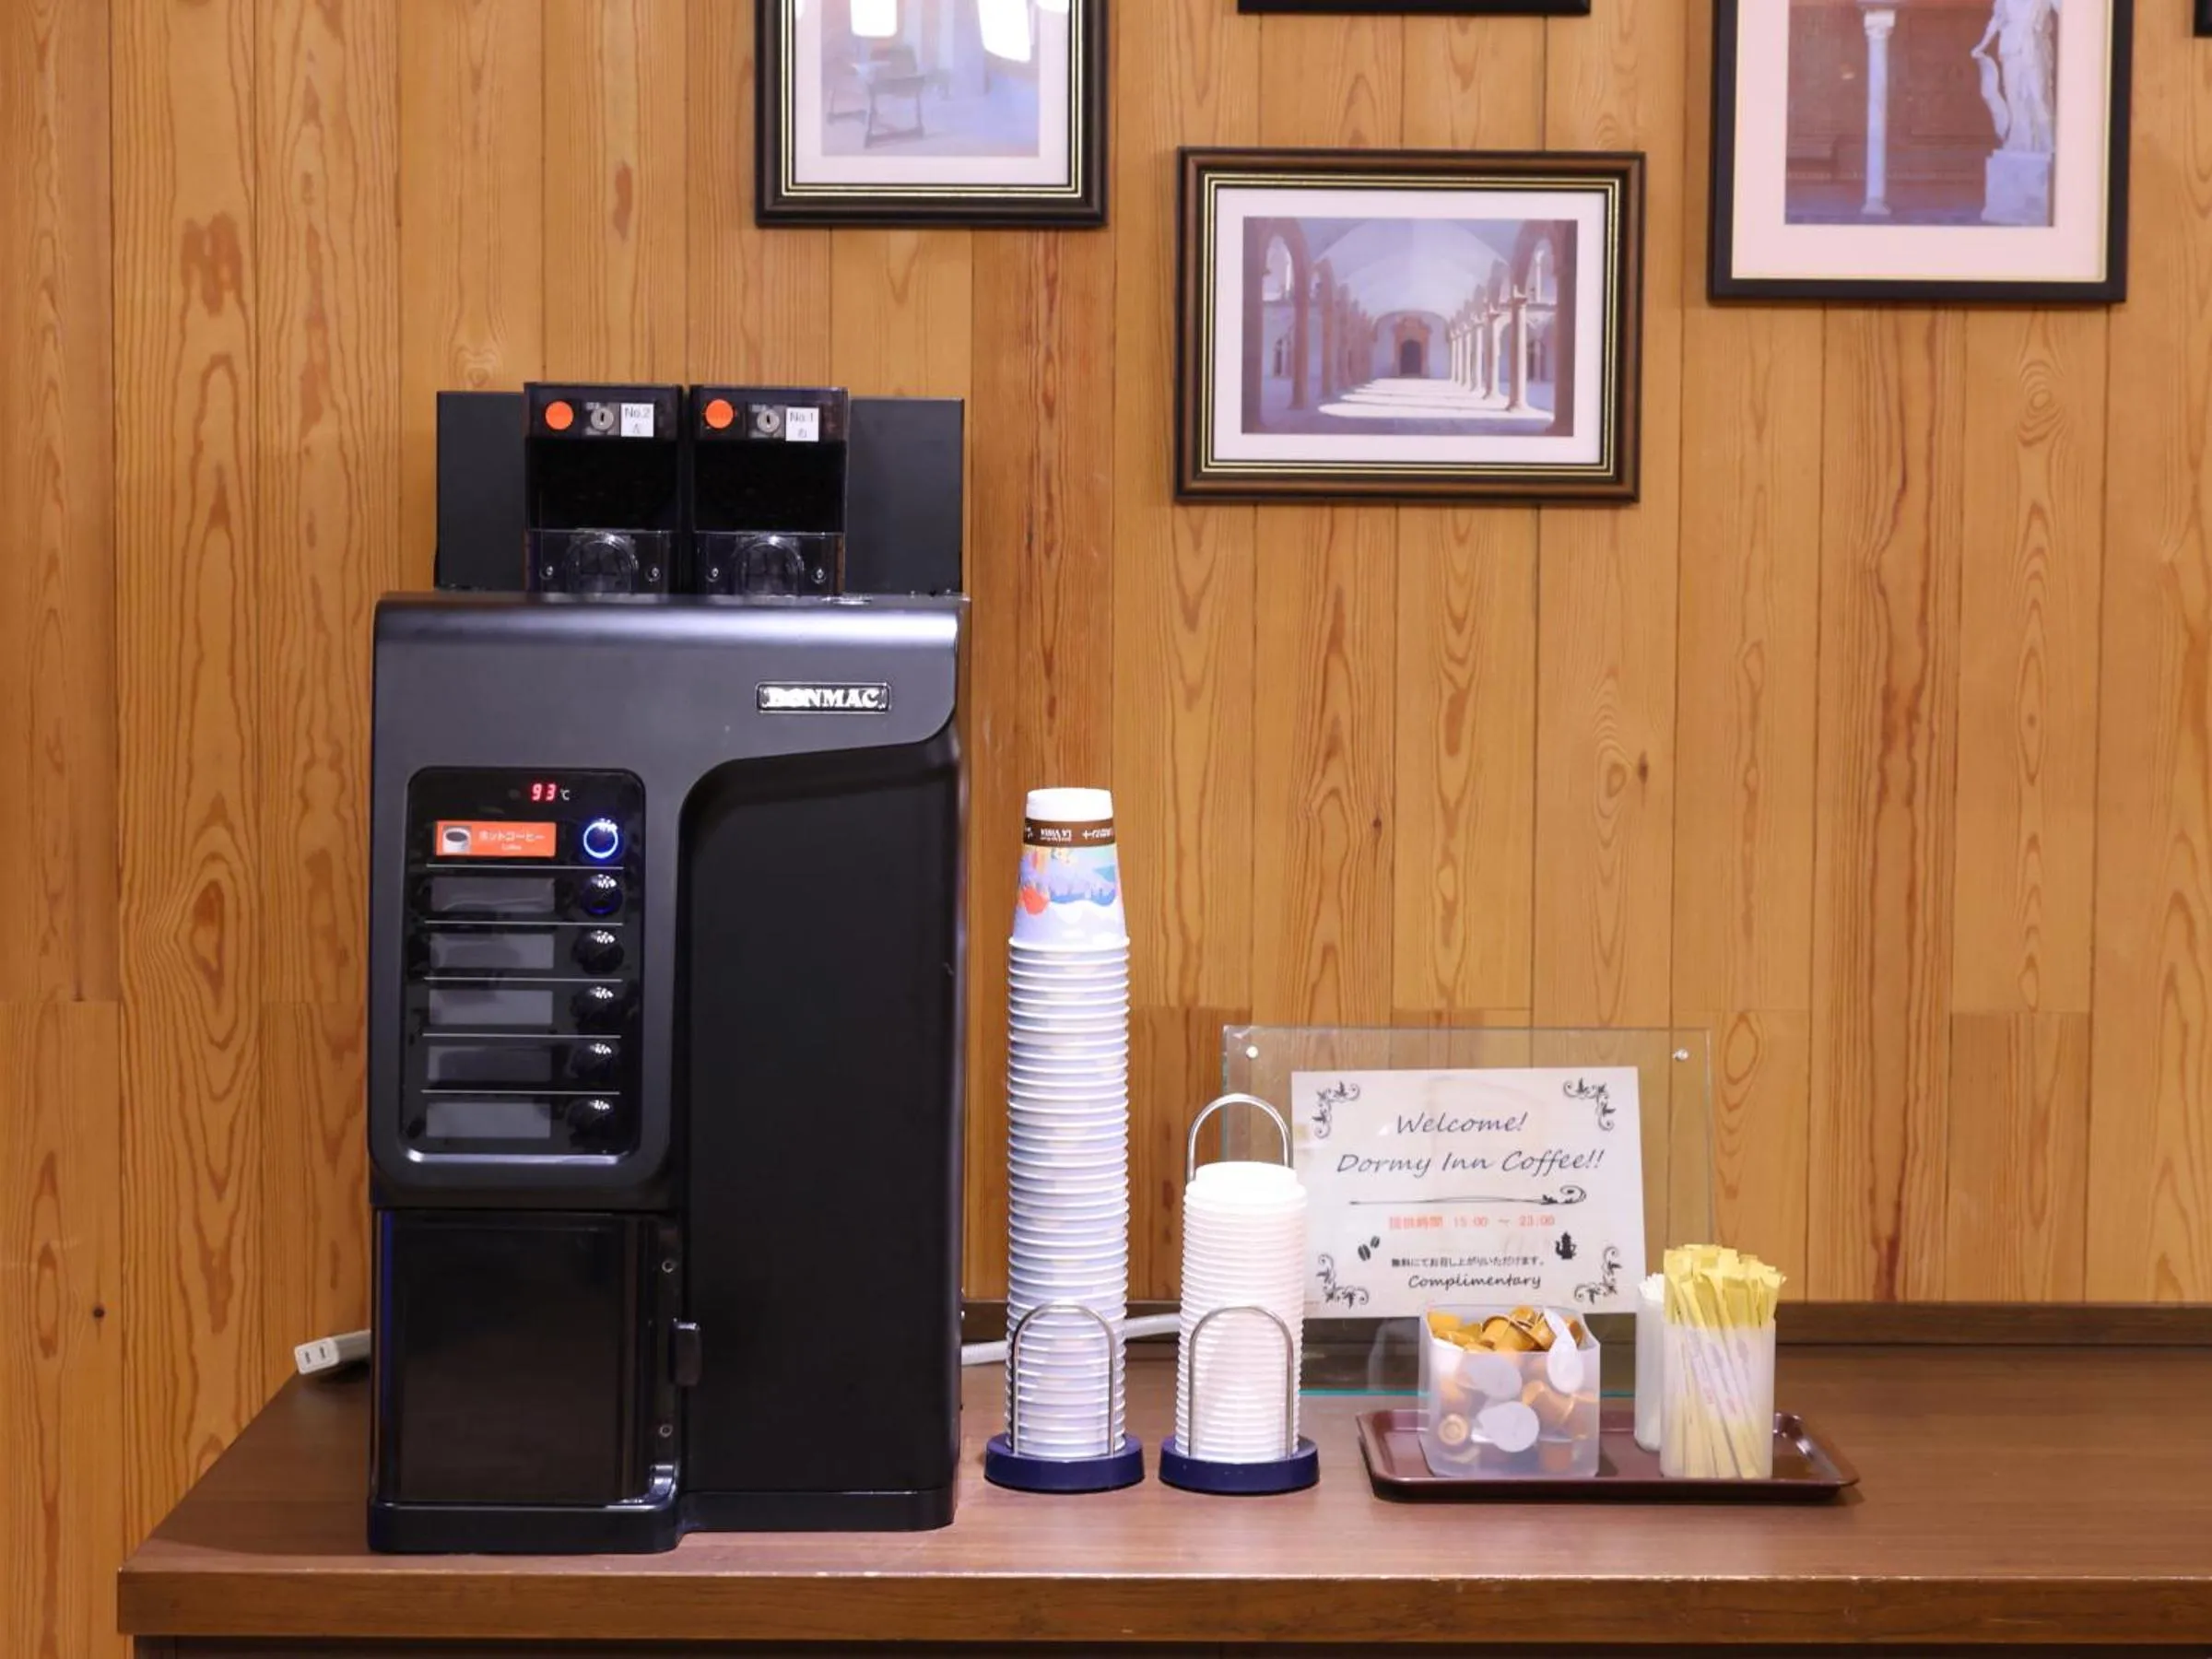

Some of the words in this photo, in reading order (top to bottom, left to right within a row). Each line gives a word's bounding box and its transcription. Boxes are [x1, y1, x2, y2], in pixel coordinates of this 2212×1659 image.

[532, 783, 557, 801] 93
[478, 830, 546, 842] ホットコーヒー
[1396, 1112, 1529, 1135] Welcome!
[1336, 1153, 1431, 1179] Dormy
[1441, 1151, 1493, 1172] Inn
[1501, 1149, 1606, 1178] Coffee!!
[1407, 1274, 1542, 1291] Complimentary
